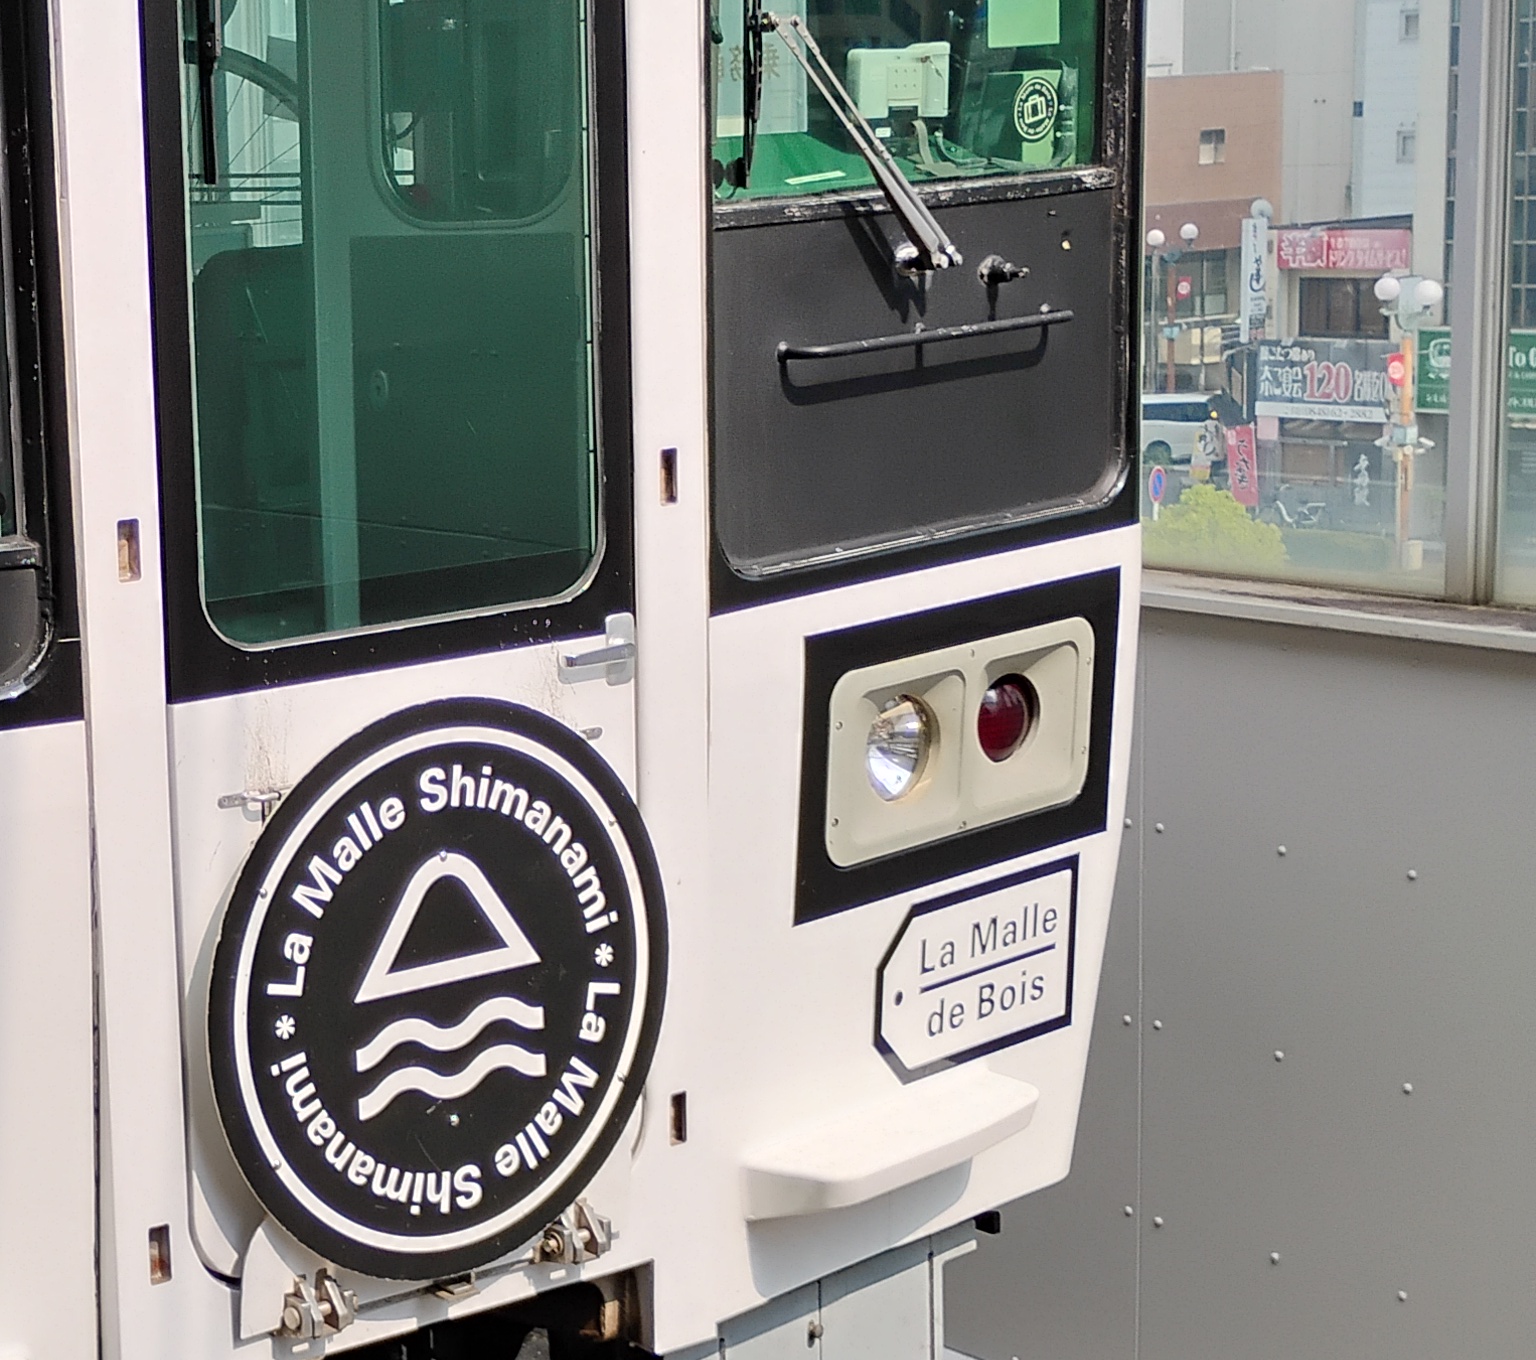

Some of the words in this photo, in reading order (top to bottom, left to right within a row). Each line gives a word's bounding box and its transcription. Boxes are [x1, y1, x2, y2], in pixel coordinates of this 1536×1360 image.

[1303, 361, 1353, 403] 120
[266, 930, 314, 997] La
[292, 798, 407, 920] Malle
[418, 765, 619, 934] Shimanami
[920, 938, 955, 975] La
[970, 902, 1058, 958] Malle
[586, 981, 621, 1044] La
[927, 998, 965, 1037] de
[977, 970, 1045, 1021] Bois
[270, 1051, 483, 1216] Shimanami
[495, 1056, 600, 1179] Malle
